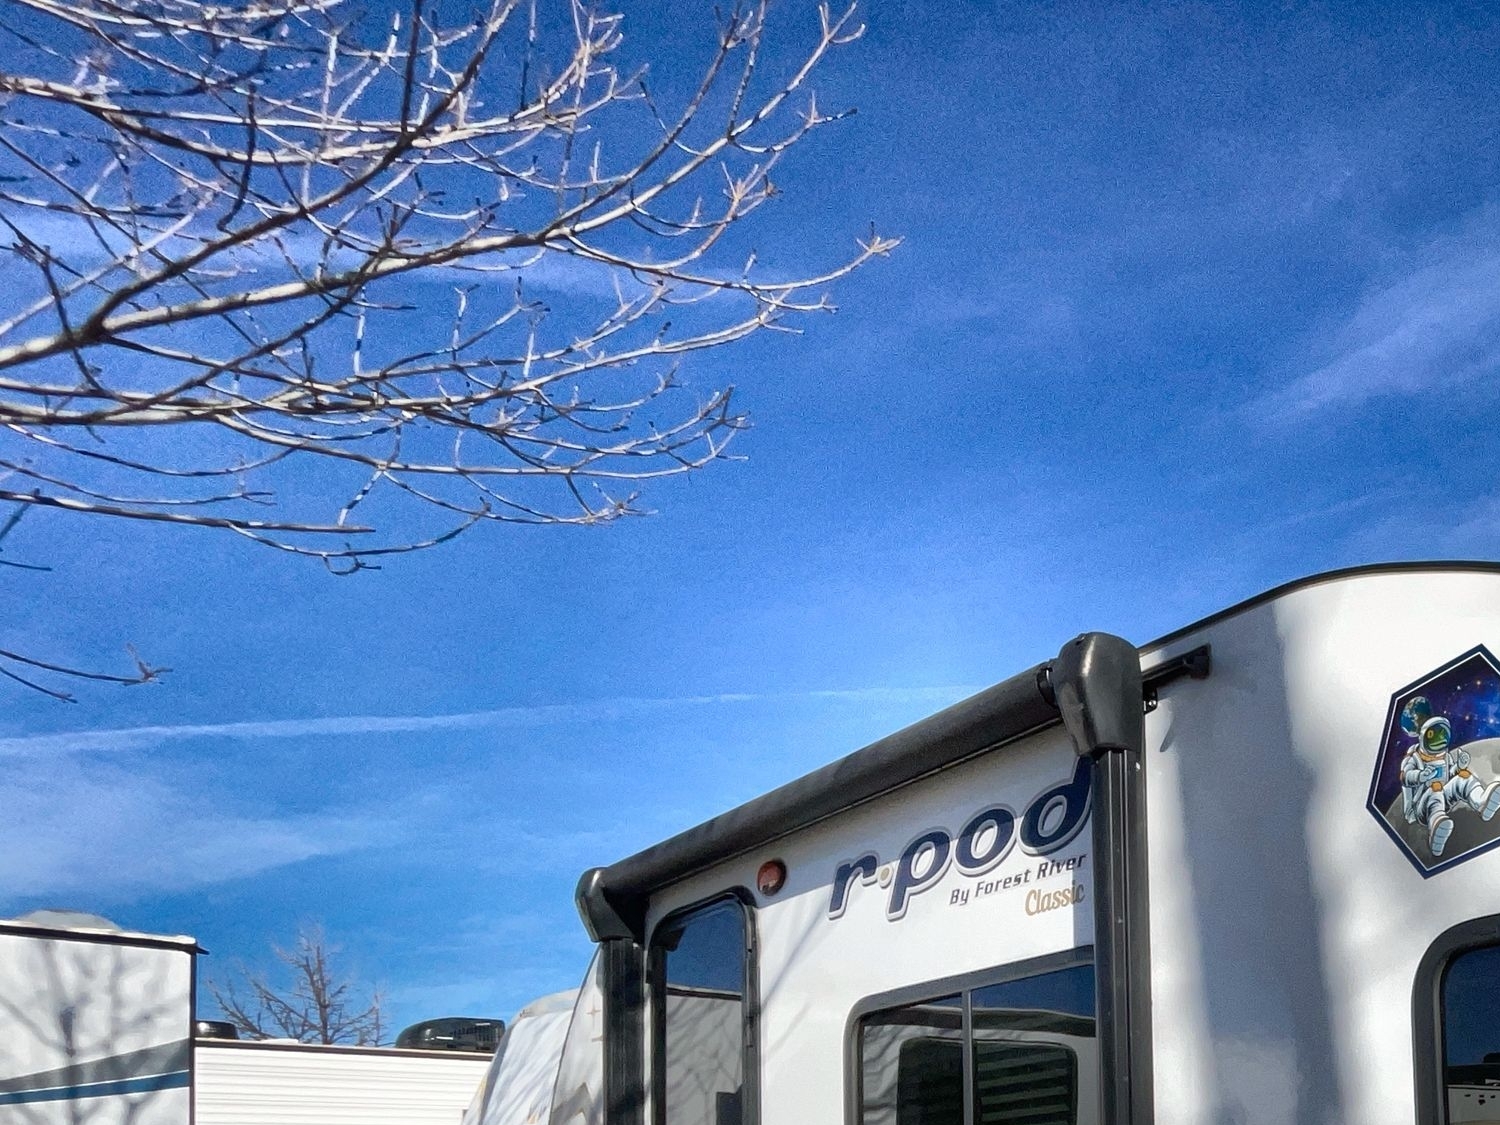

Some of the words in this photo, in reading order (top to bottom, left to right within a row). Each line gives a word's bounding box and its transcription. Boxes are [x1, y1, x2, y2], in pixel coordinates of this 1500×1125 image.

[950, 889, 968, 905] By
[975, 868, 1031, 898] Forest
[1036, 852, 1086, 880] River
[1025, 880, 1085, 916] Classic
